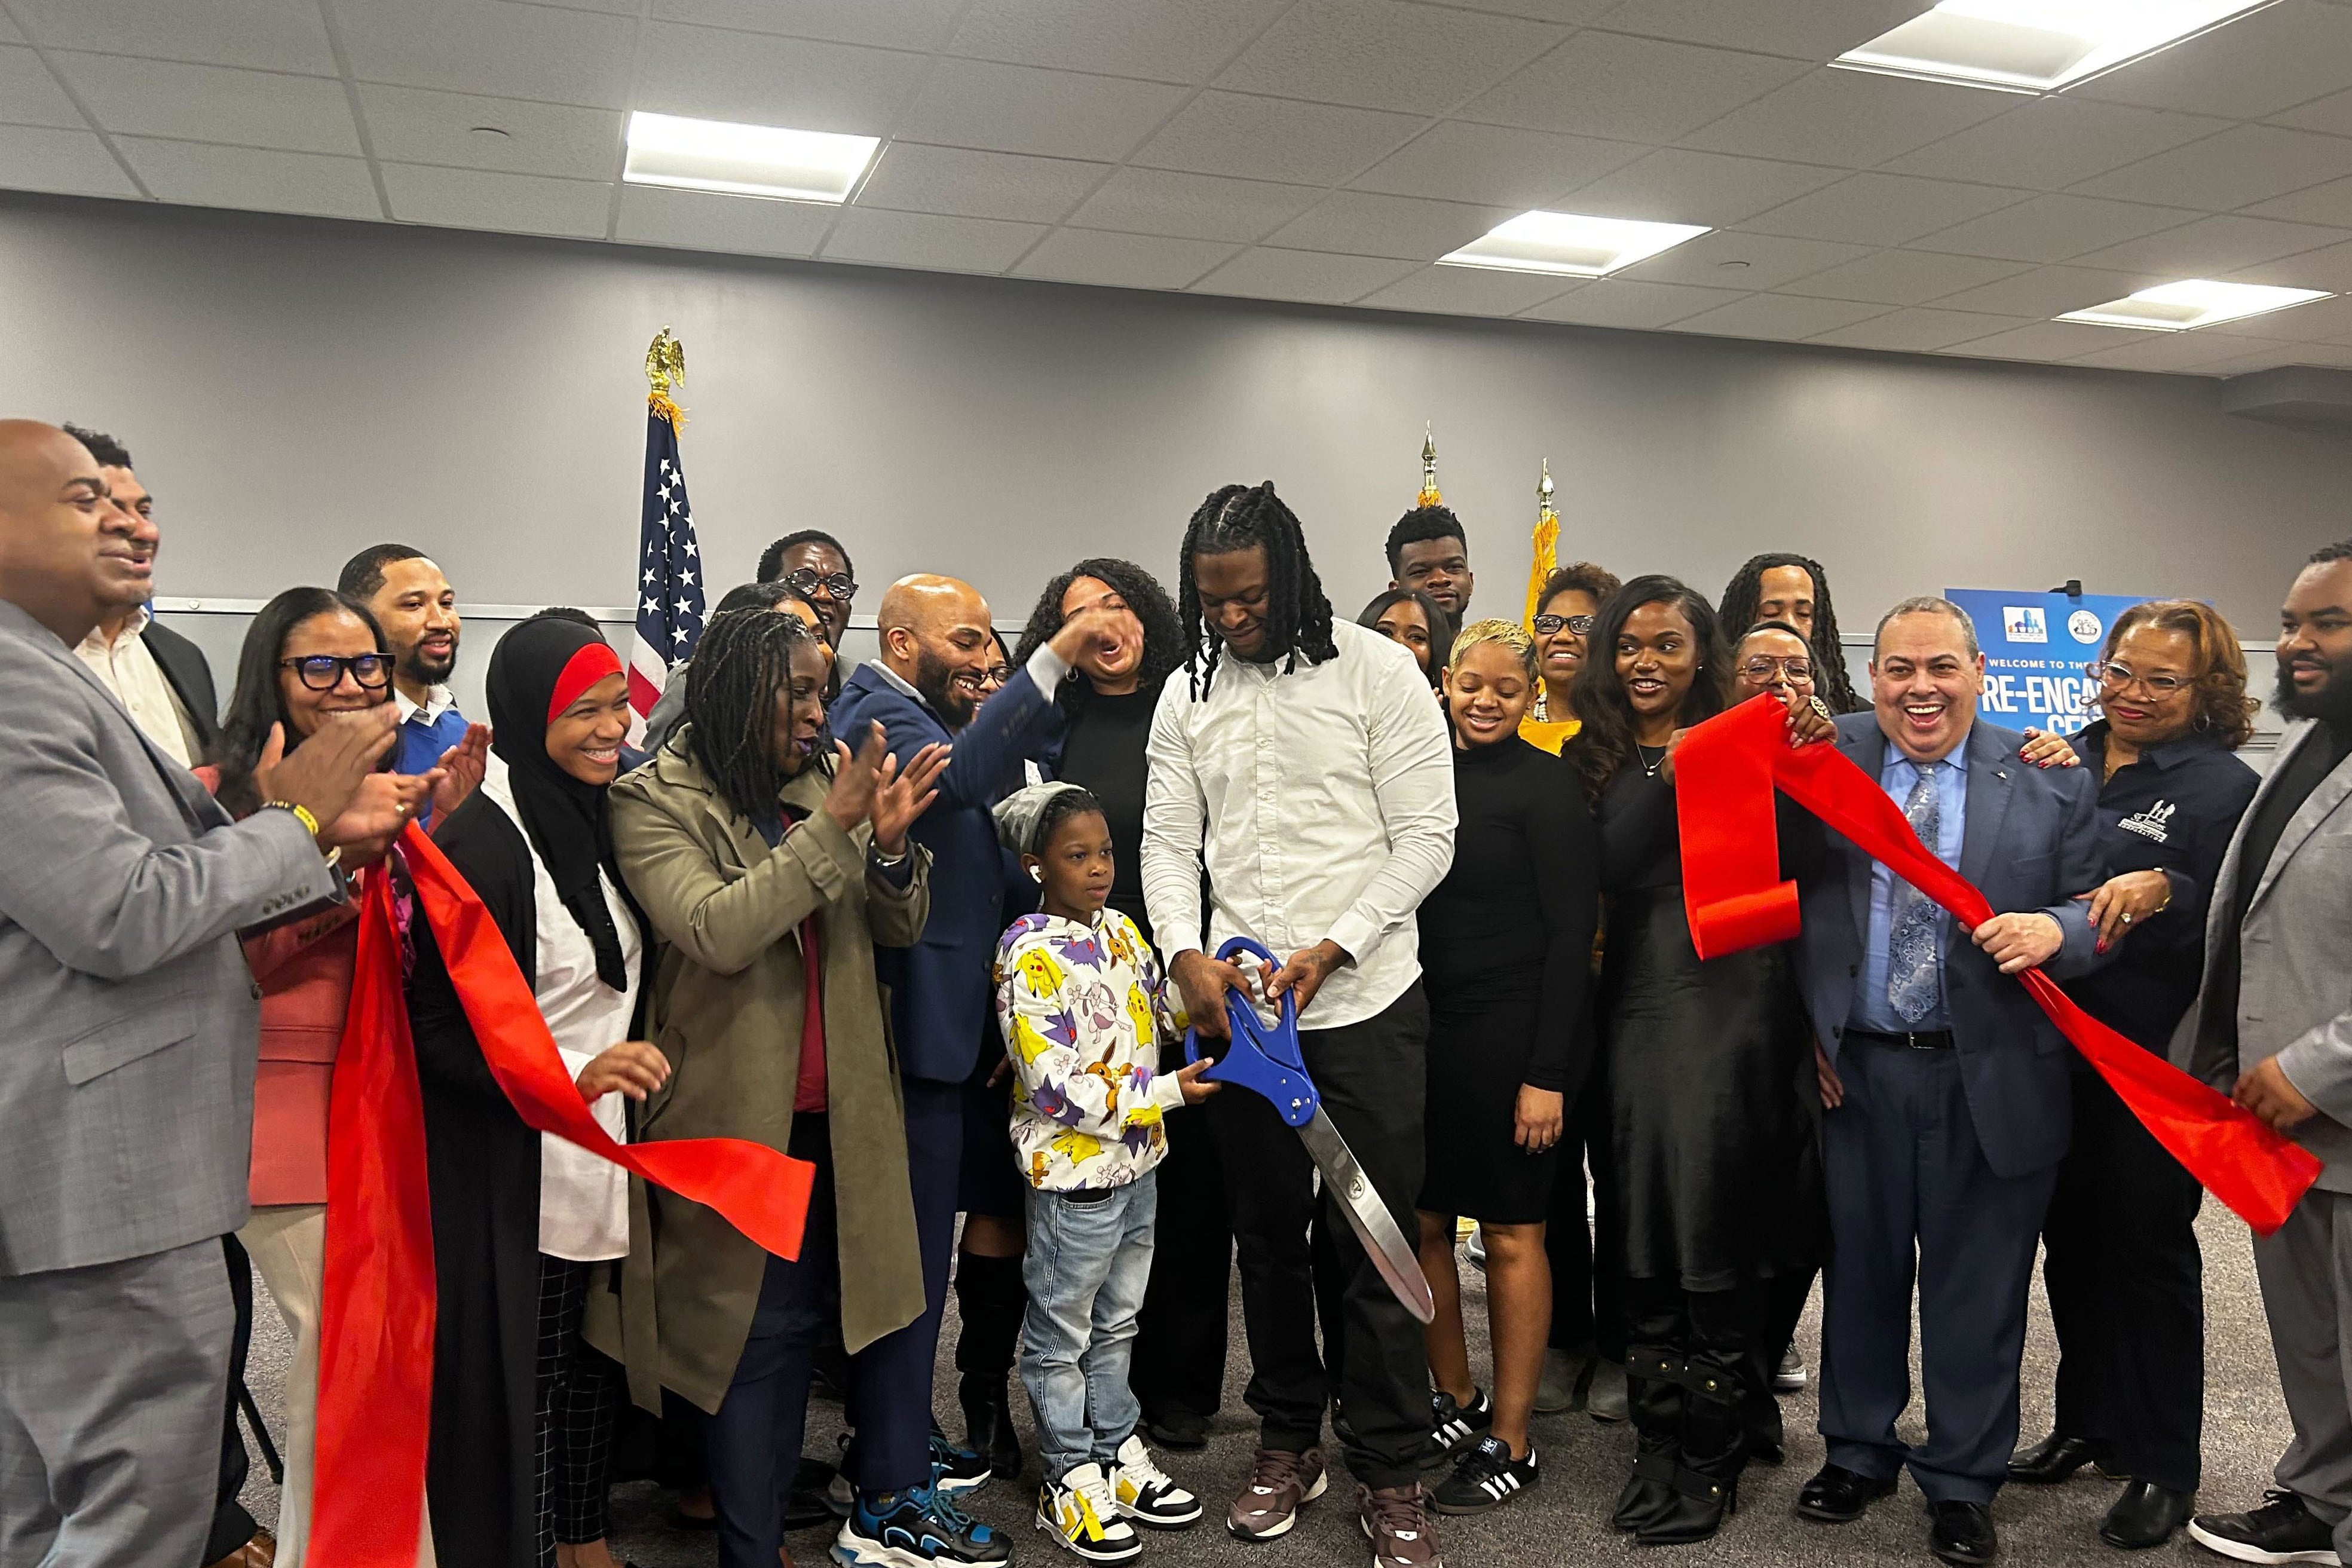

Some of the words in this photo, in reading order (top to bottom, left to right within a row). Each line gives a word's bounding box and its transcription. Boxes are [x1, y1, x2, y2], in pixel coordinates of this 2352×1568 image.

[1989, 659, 2045, 669] WELCOME
[2049, 660, 2064, 669] TO
[1982, 675, 2102, 715] RE-ENGA
